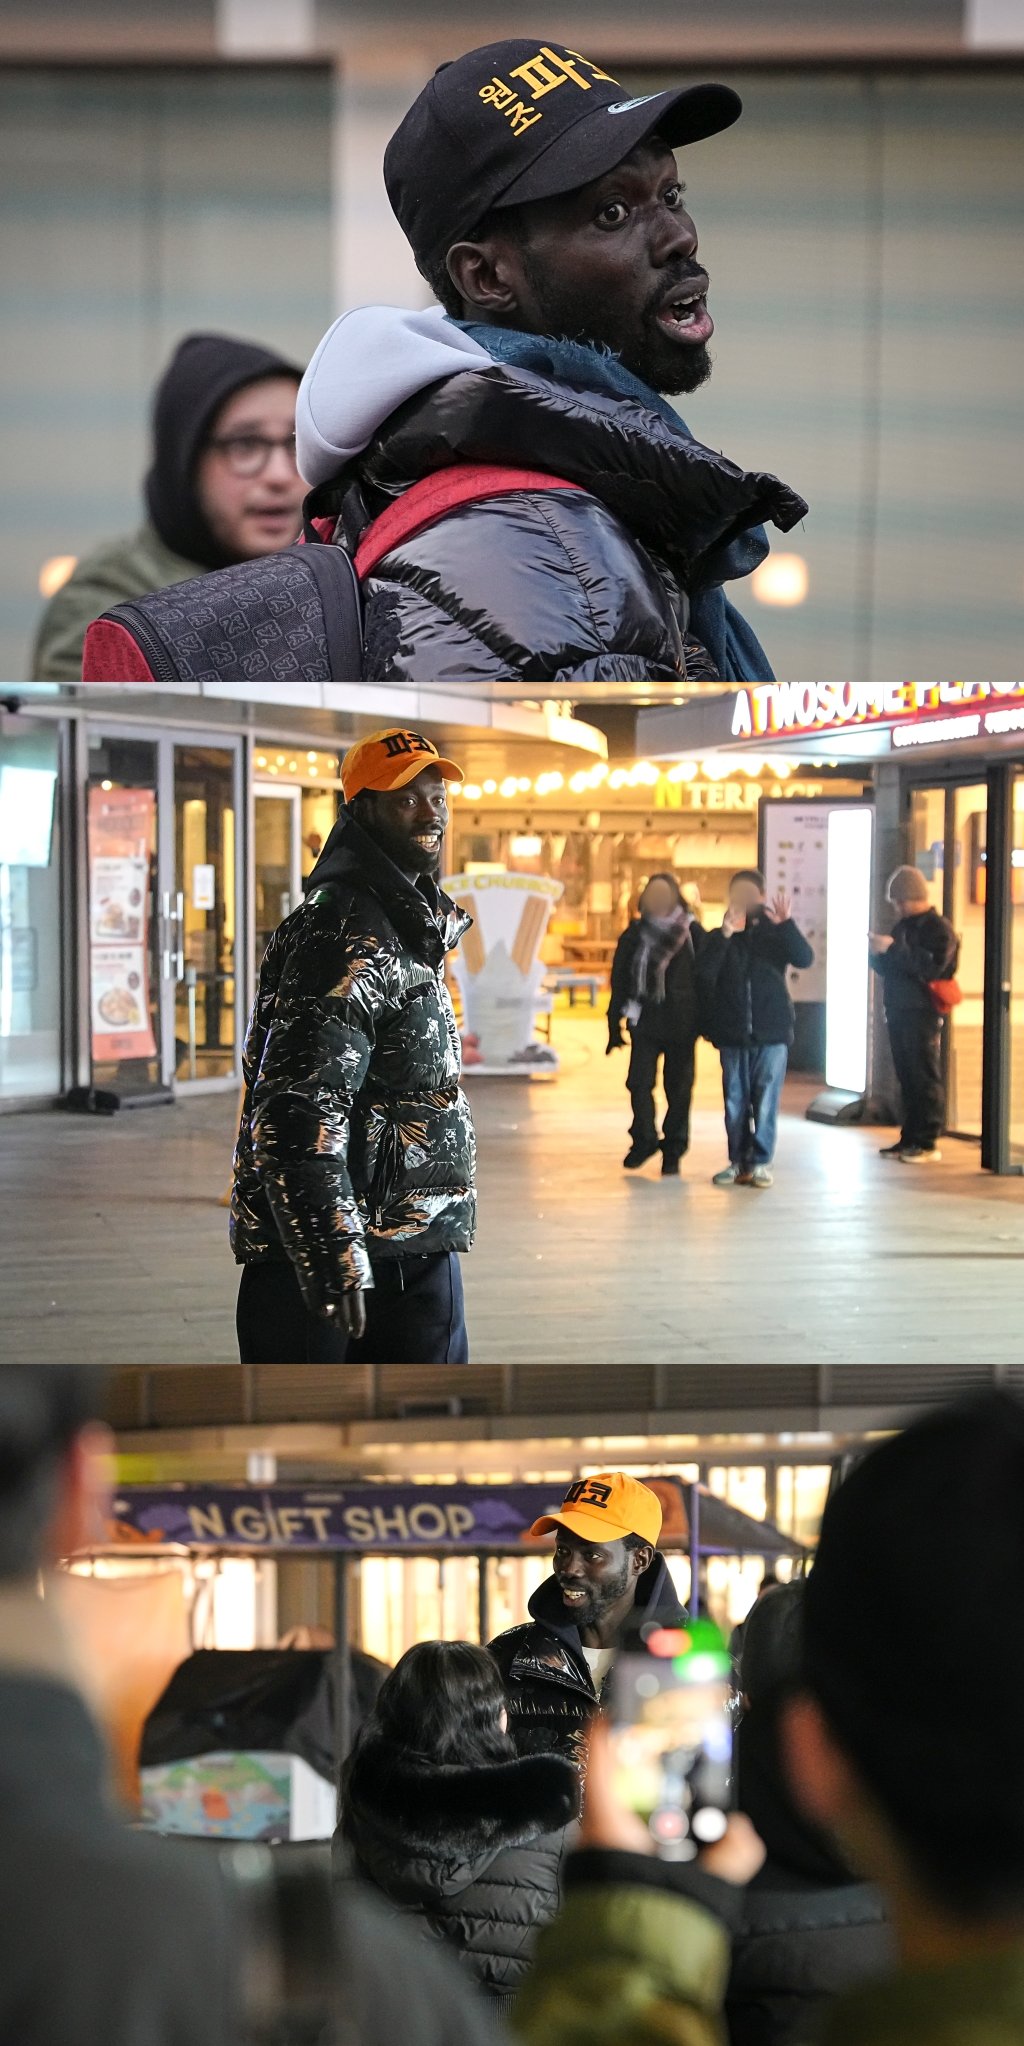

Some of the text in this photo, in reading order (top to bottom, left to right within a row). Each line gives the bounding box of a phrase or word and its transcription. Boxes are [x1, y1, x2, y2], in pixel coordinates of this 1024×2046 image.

[478, 77, 543, 137] 원조
[731, 689, 752, 735] A
[753, 682, 906, 732] TWOSOME
[656, 779, 682, 809] N
[187, 1502, 475, 1543] N GIFT SHOP
